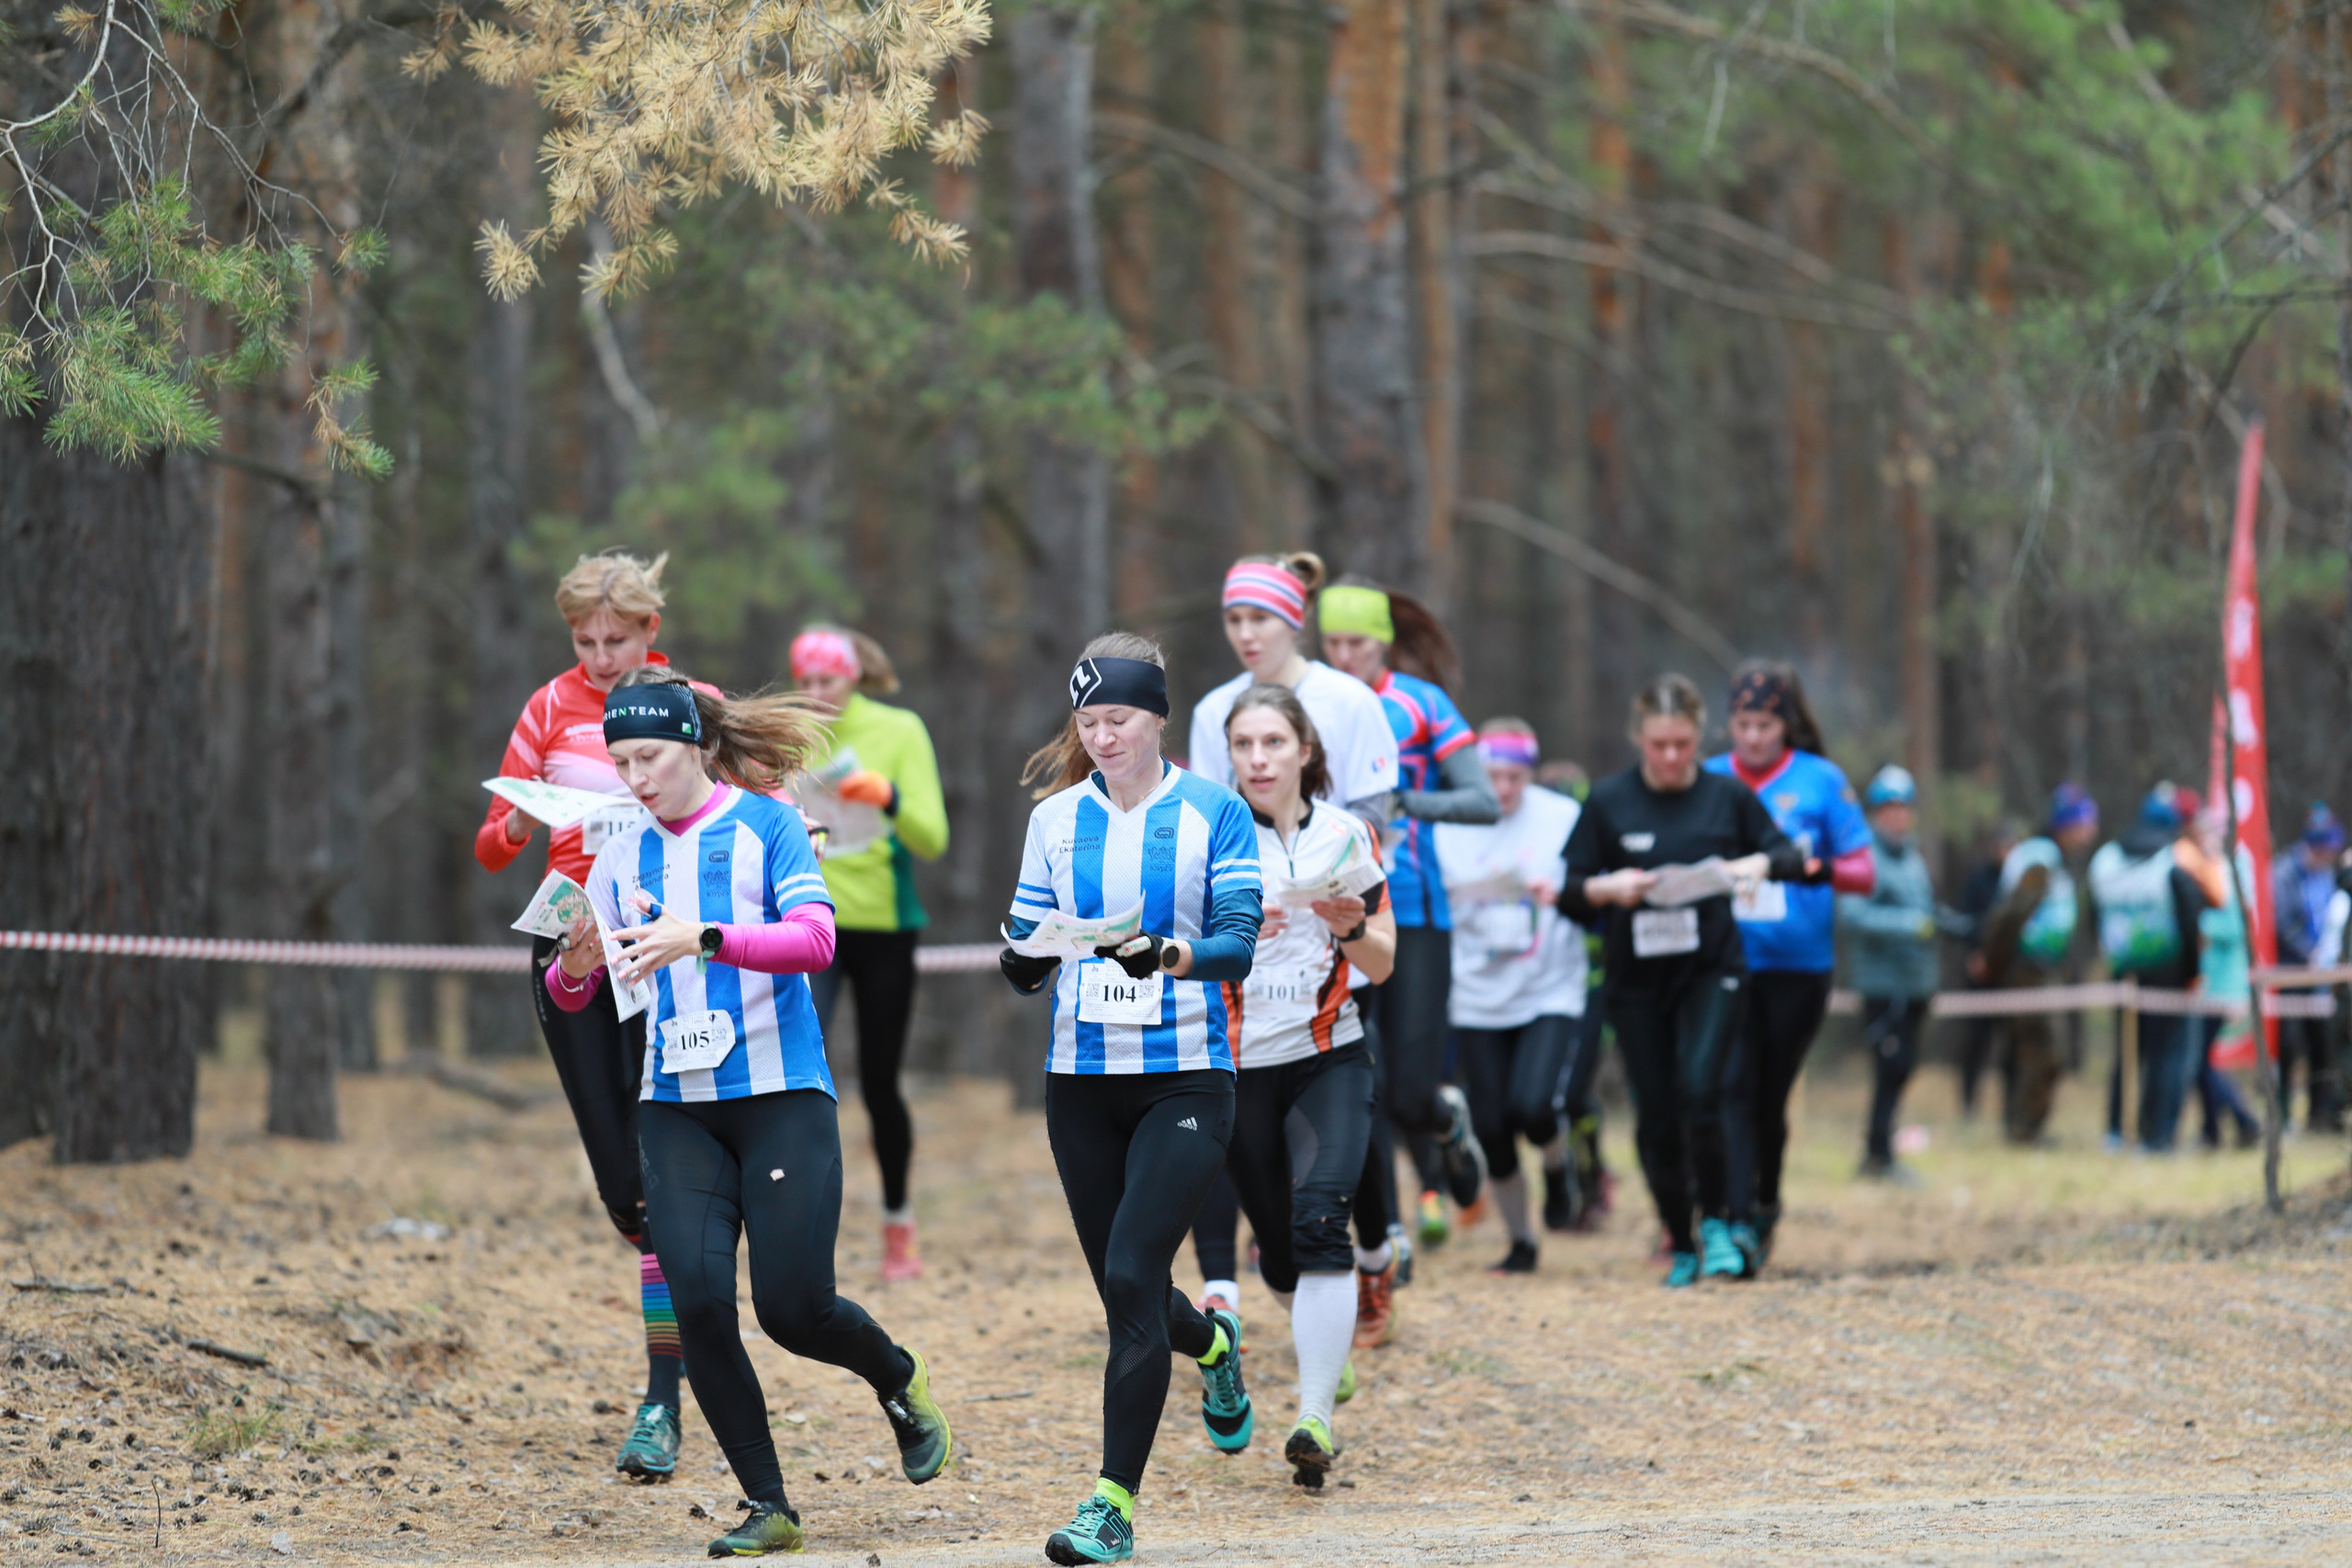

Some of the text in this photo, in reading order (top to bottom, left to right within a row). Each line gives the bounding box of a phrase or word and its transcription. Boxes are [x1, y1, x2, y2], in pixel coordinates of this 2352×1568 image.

[1059, 844, 1101, 853] Ekaterina
[1103, 984, 1136, 1003] 104
[1268, 985, 1295, 1000] 101
[681, 1031, 710, 1051] 105
